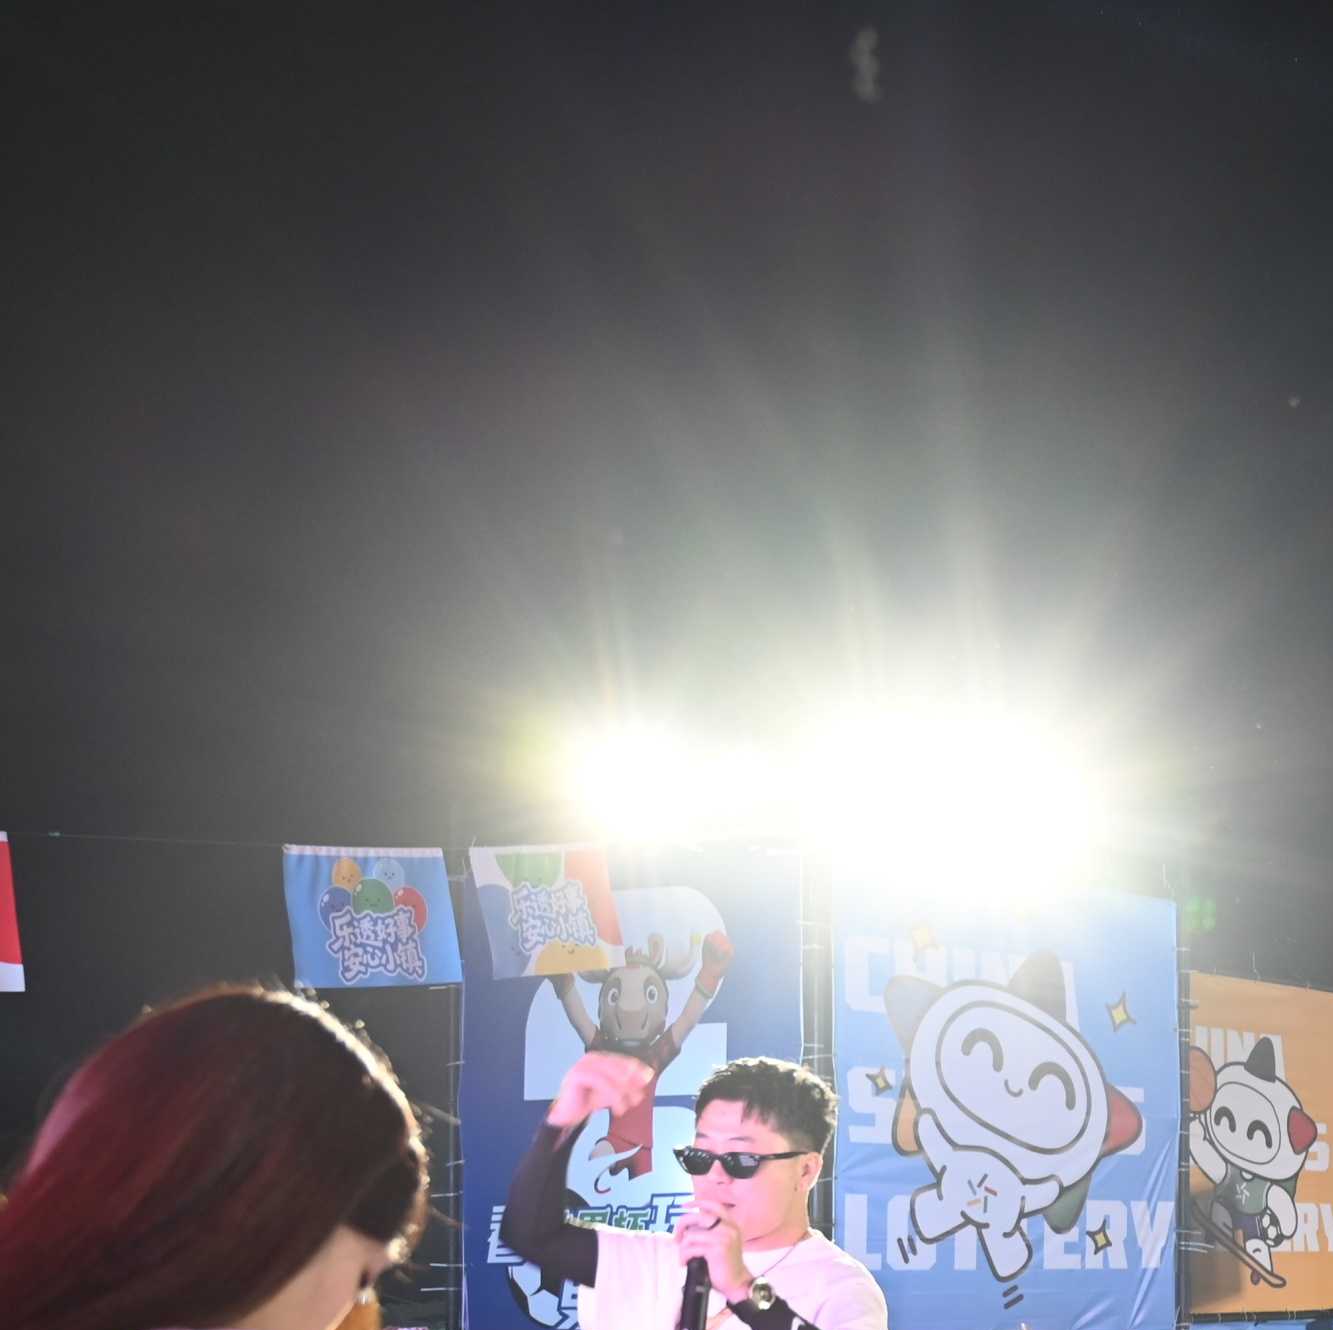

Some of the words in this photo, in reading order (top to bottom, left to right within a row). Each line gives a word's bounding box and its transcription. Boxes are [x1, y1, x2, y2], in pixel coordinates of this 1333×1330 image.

[513, 885, 587, 925] 乐透好事
[331, 909, 418, 949] 乐透好事
[522, 912, 598, 949] 安心小镇
[341, 941, 426, 980] 安心小镇
[844, 1193, 1175, 1271] LOERY
